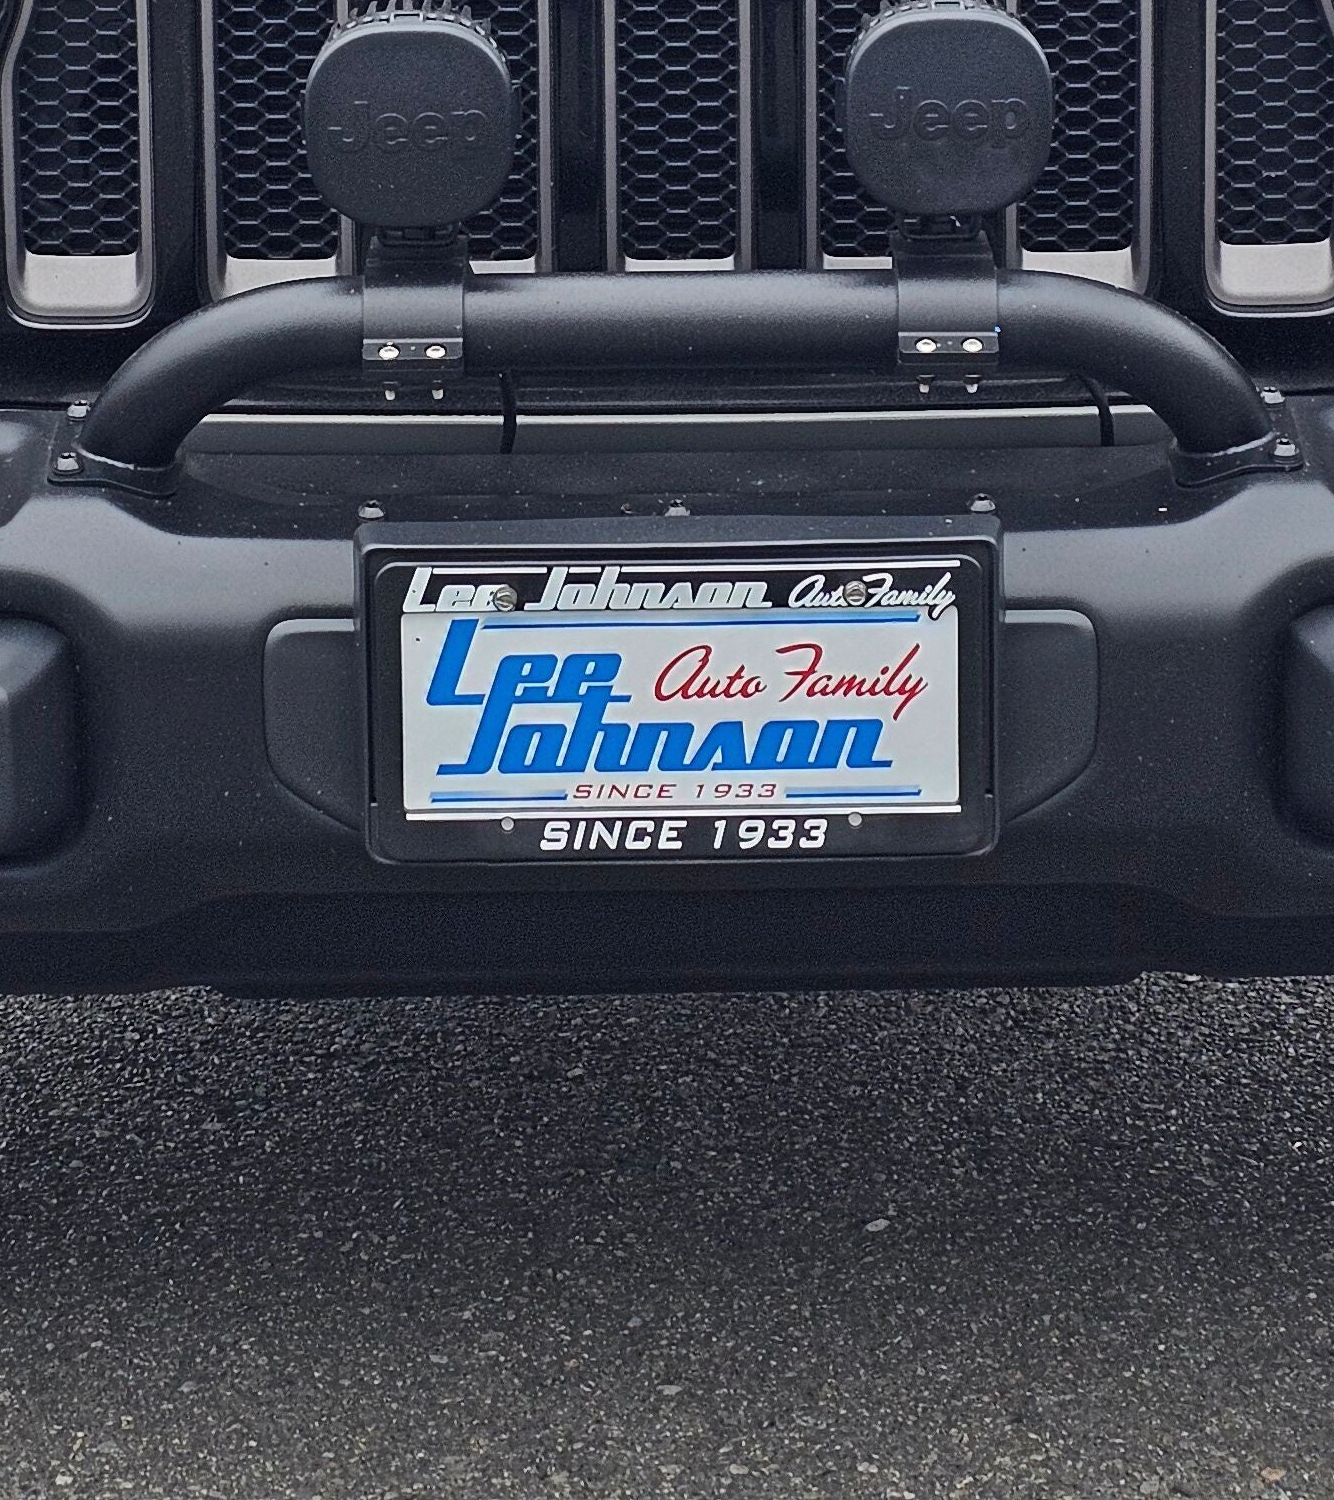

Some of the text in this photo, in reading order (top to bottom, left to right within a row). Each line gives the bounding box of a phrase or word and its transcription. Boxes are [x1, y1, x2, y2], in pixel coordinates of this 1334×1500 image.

[326, 97, 489, 155] Jeep
[869, 86, 1029, 148] Jeep
[523, 565, 773, 611] Johnson
[788, 574, 865, 608] Aut
[862, 571, 956, 619] Family
[426, 618, 929, 721] Lee Auto Family
[436, 694, 893, 775] Johnson
[572, 783, 778, 800] SINCE 1933
[539, 818, 828, 850] SINCE 1933
